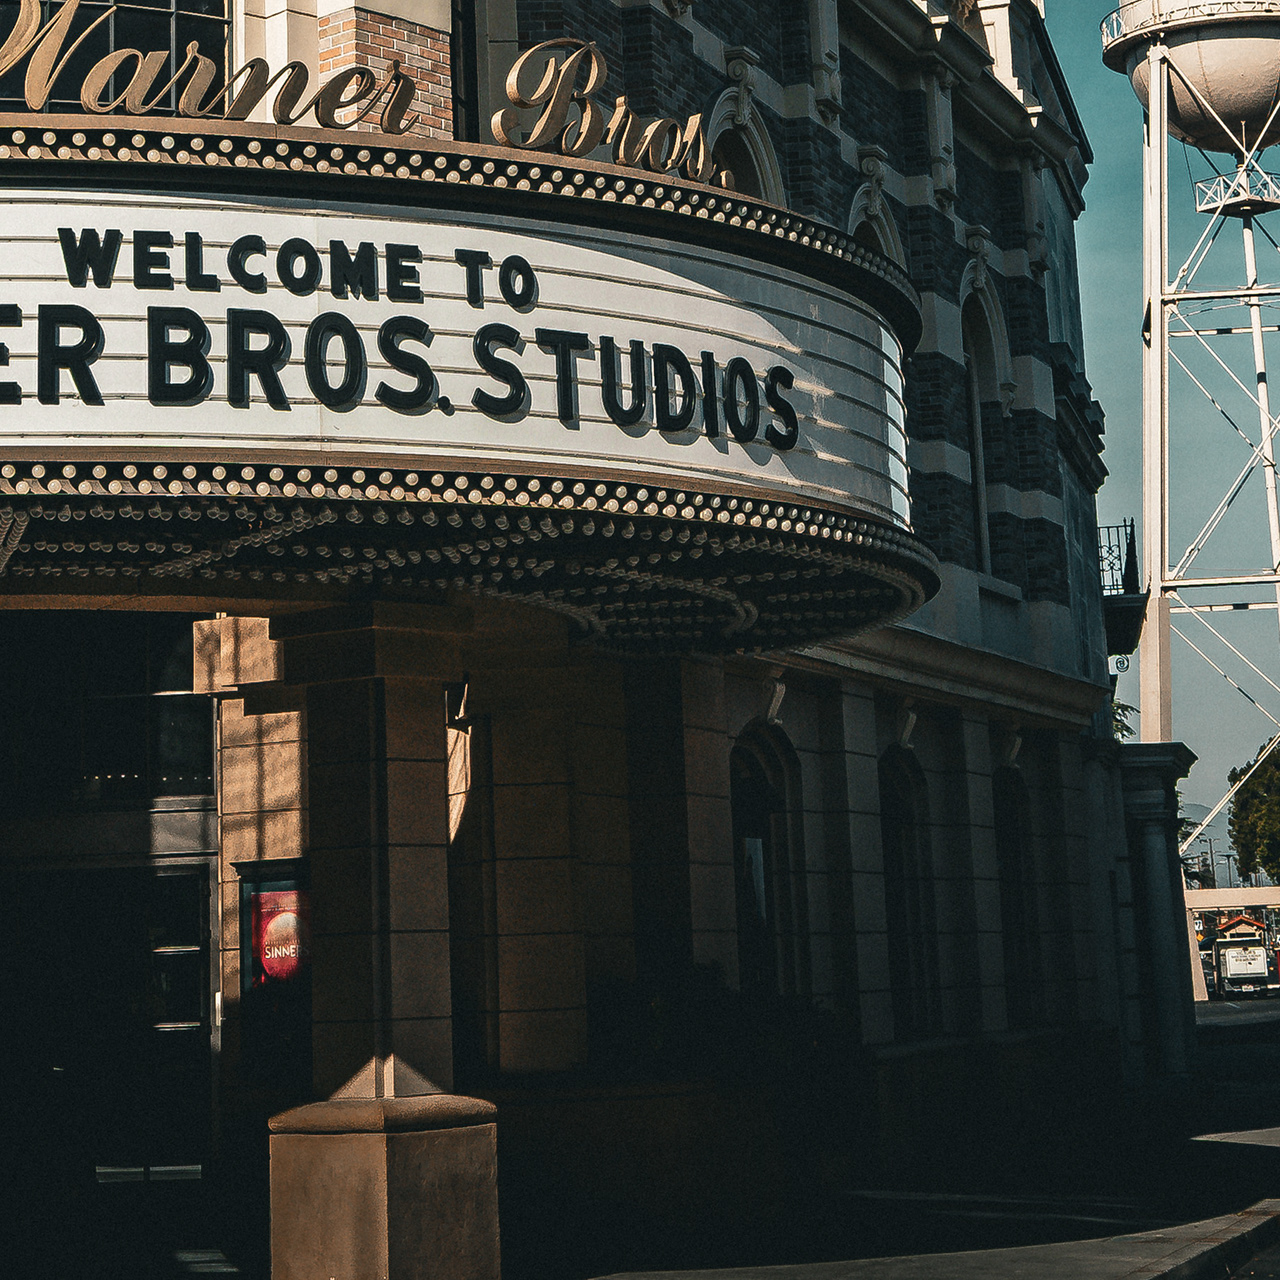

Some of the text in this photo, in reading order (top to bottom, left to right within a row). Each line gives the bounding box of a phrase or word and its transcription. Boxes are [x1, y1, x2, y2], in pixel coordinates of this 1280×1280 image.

[491, 37, 735, 190] Bros.
[58, 228, 538, 314] WELCOME TO
[147, 305, 455, 417] BROS.
[472, 323, 800, 452] STUDIOS
